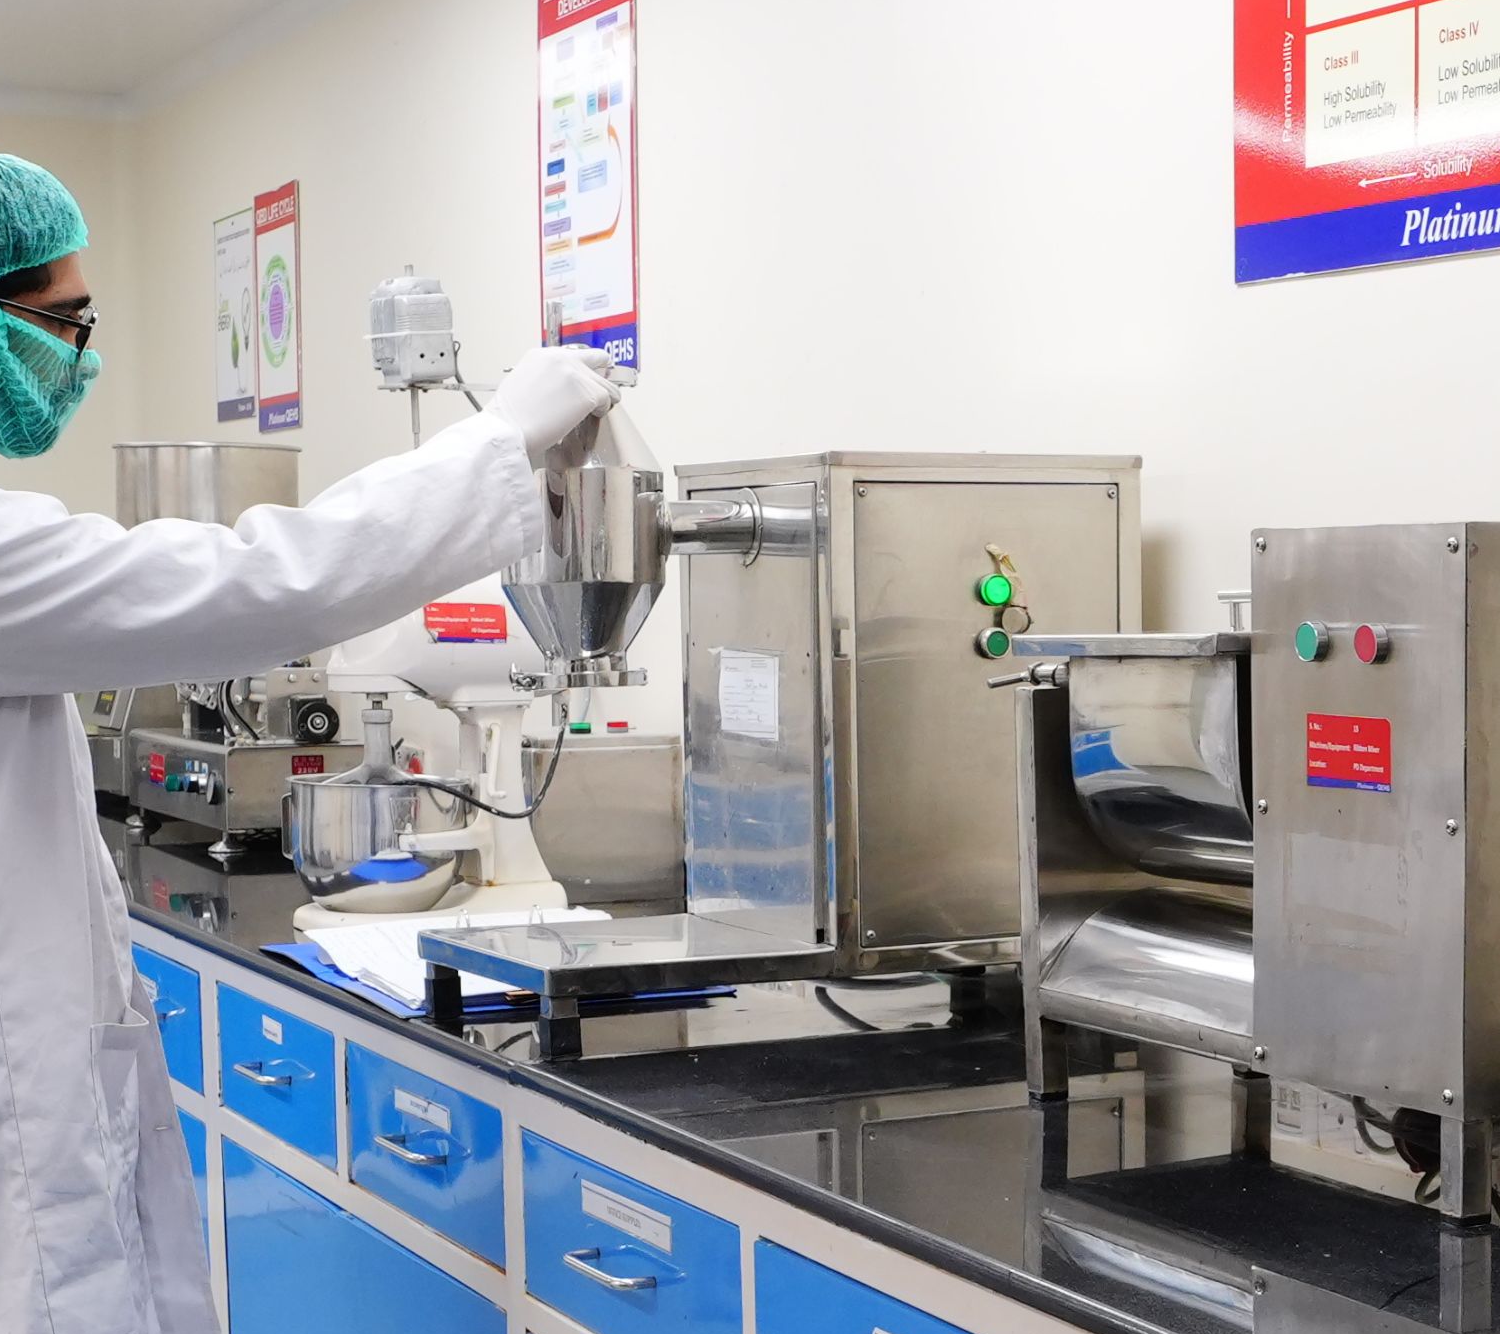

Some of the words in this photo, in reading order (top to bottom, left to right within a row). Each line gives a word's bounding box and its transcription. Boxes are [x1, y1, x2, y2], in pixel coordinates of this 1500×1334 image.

[1438, 26, 1466, 44] Class
[1469, 20, 1479, 35] IV
[1324, 55, 1348, 71] Class
[1438, 65, 1459, 82] Low
[1282, 31, 1294, 143] Permeability
[1324, 90, 1343, 109] High
[1344, 80, 1386, 103] Solubility
[1438, 89, 1458, 105] Low
[1323, 114, 1342, 129] Low
[1344, 102, 1397, 124] Permeability
[1423, 155, 1473, 178] Solubility
